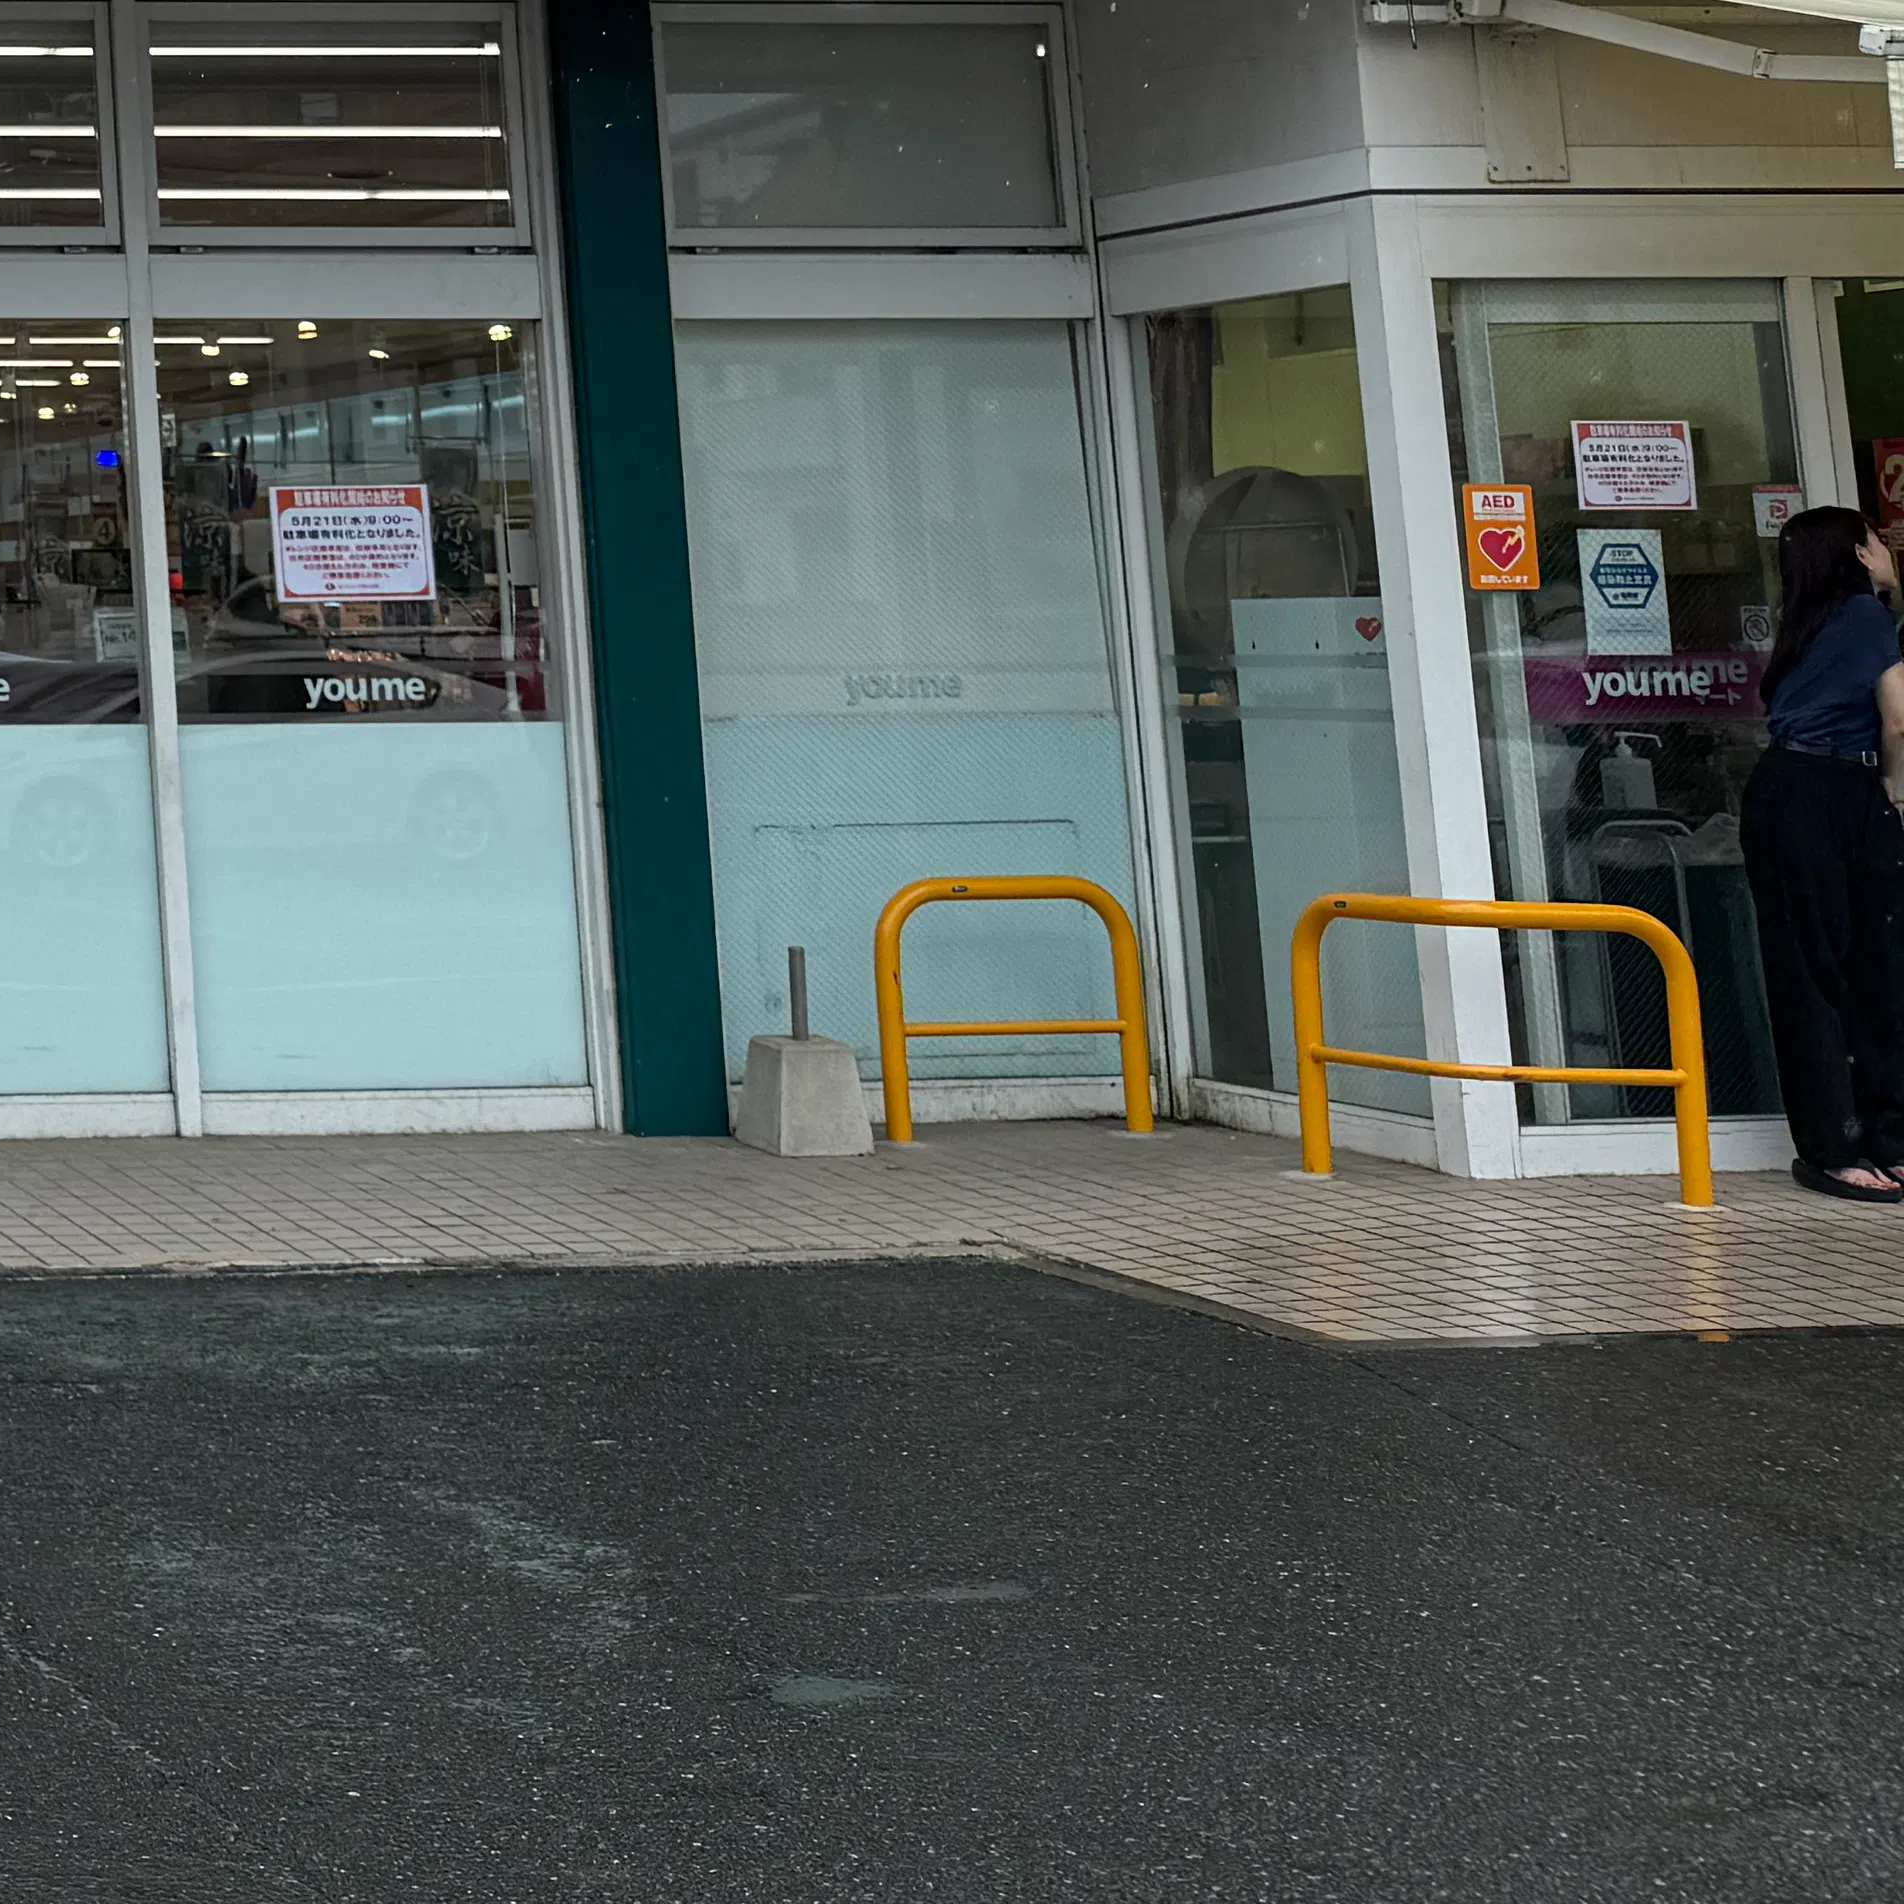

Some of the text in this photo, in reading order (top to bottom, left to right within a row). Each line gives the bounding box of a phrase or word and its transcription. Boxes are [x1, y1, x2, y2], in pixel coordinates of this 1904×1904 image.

[1482, 495, 1515, 509] AED
[305, 676, 428, 709] youme
[1581, 668, 1711, 706] youme
